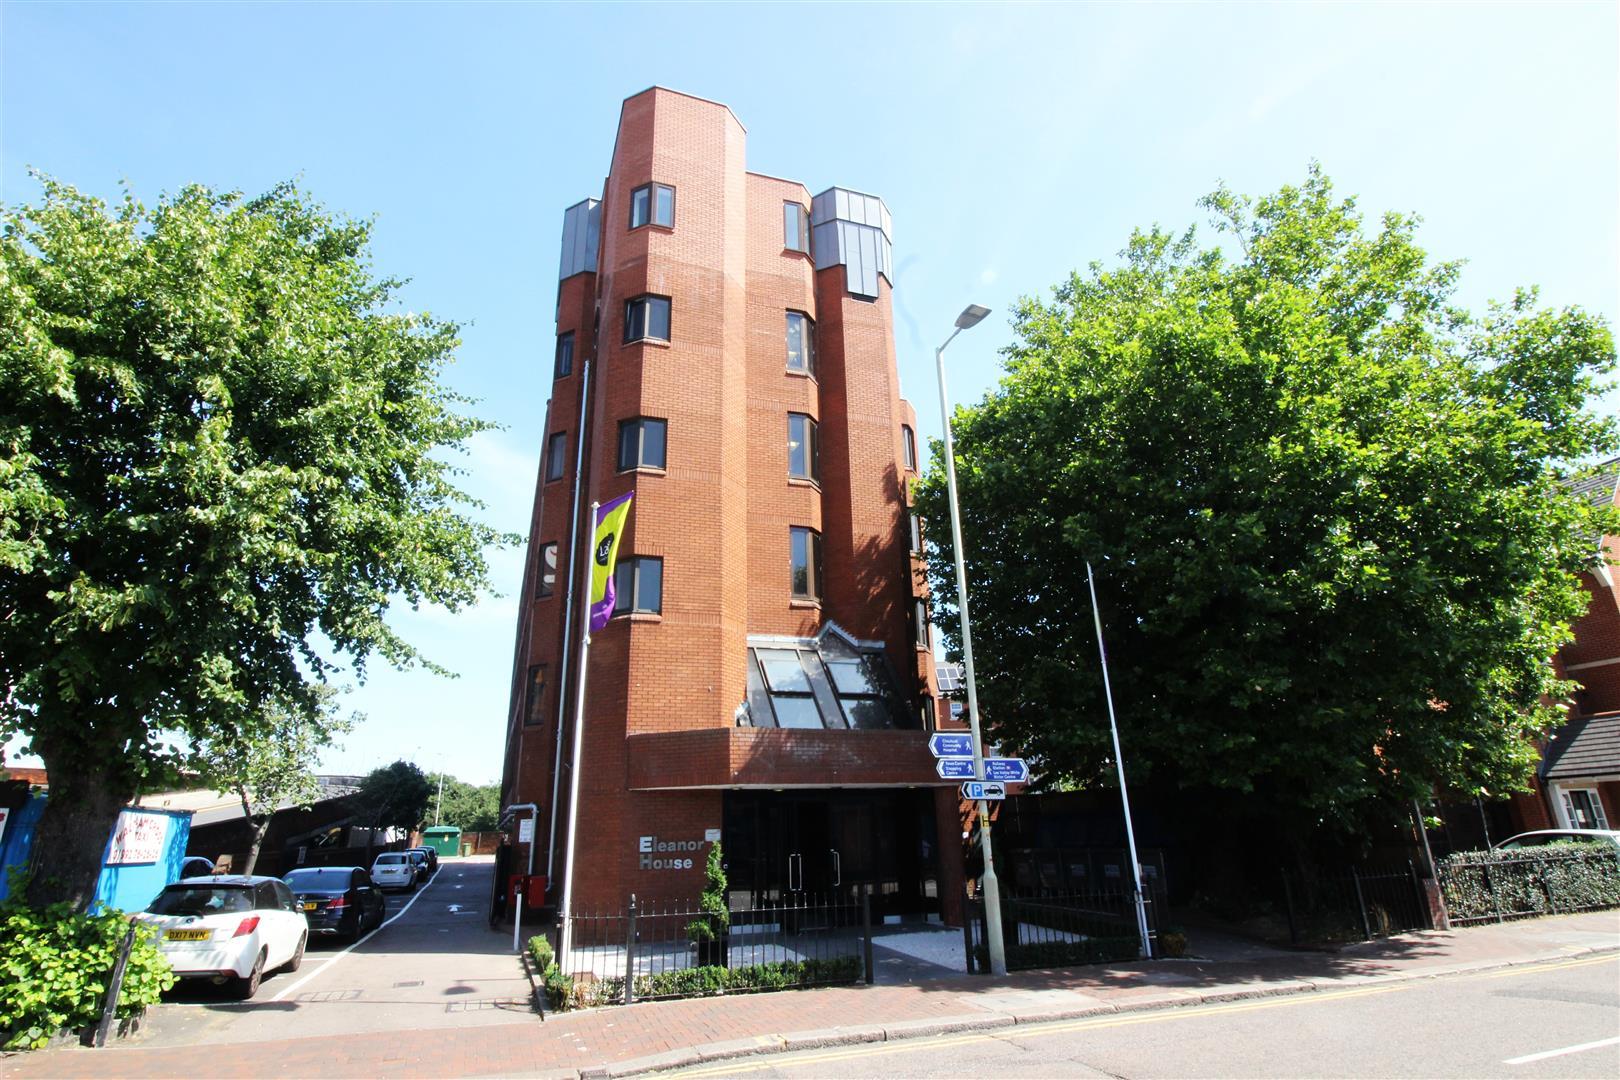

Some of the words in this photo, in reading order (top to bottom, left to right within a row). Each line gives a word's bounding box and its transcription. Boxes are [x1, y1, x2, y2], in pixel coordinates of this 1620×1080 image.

[973, 785, 981, 797] P
[640, 836, 704, 852] Eleanor
[640, 854, 692, 870] House
